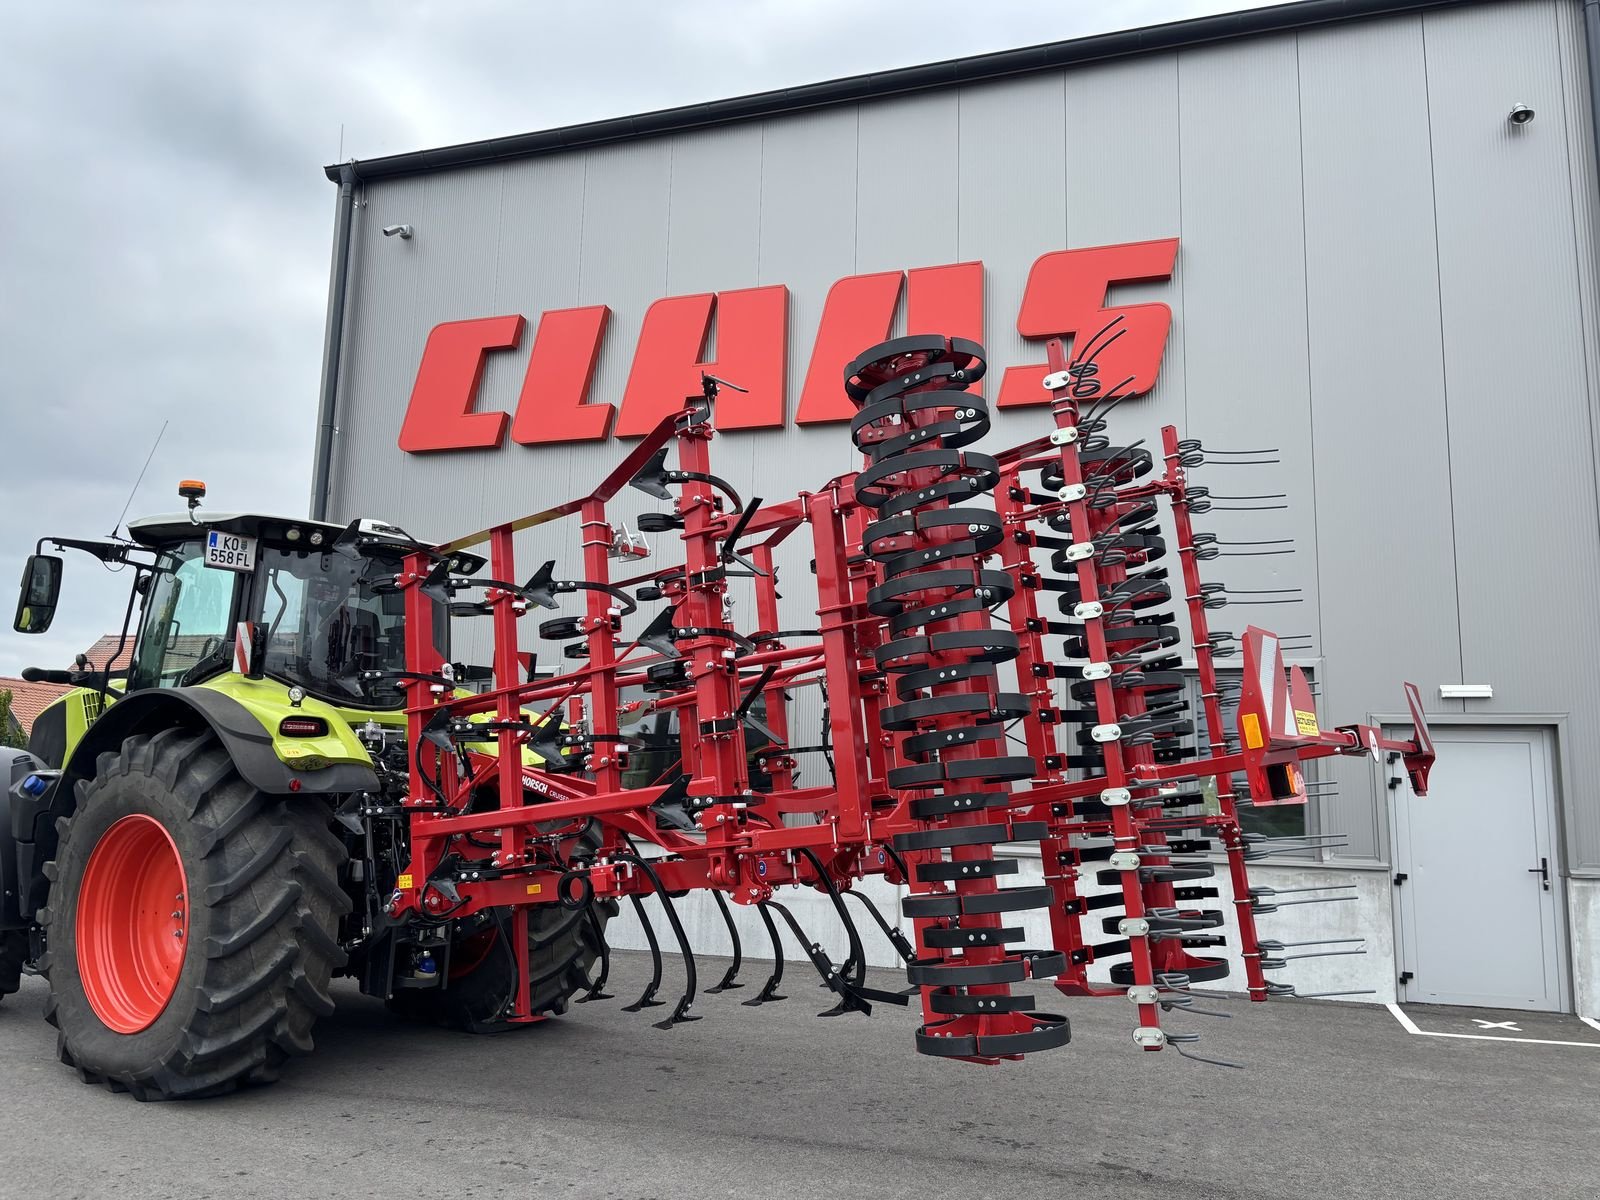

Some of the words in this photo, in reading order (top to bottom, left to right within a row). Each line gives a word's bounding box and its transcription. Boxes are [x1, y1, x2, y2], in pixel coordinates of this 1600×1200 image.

[399, 237, 1180, 452] CLAAS
[224, 537, 239, 551] KO
[211, 549, 234, 564] 558
[236, 553, 249, 567] FL
[522, 775, 548, 793] HORSCH
